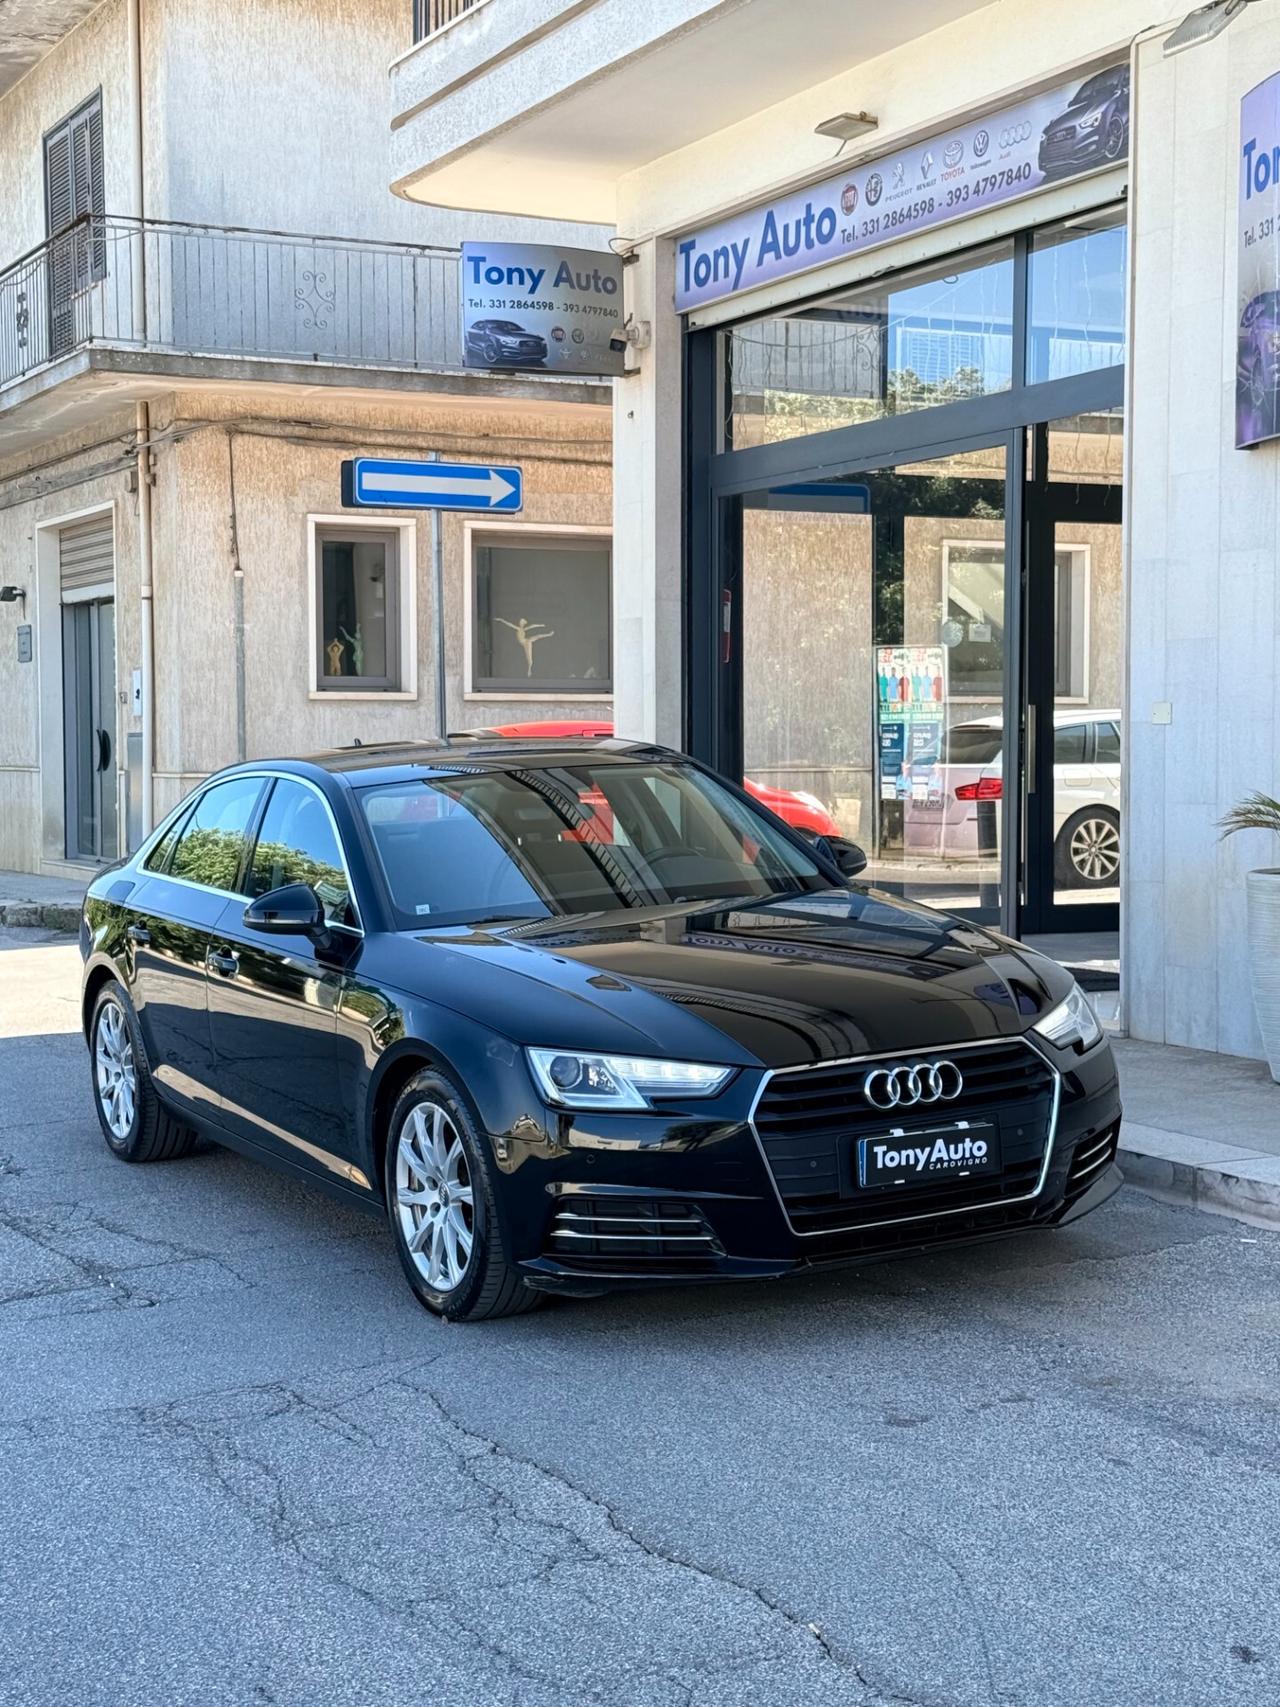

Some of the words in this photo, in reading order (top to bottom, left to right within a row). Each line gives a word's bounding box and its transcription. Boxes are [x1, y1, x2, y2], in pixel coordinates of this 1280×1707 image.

[916, 178, 937, 192] RENAULT
[940, 167, 966, 182] TOYOTA
[840, 226, 858, 245] Tel.
[862, 217, 880, 237] 331
[883, 197, 935, 231] 2864598
[946, 185, 969, 207] 393
[973, 161, 1031, 200] 4797840
[885, 188, 913, 202] PEUGEOT
[1244, 226, 1257, 248] Tel.
[1258, 217, 1274, 241] 331
[679, 236, 750, 293] Tony
[756, 202, 837, 268] Auto
[467, 256, 546, 295] Tony
[552, 260, 618, 295] Auto
[469, 298, 486, 309] Tel.
[489, 299, 506, 309] 331
[509, 299, 554, 311] 2864598
[563, 302, 580, 314] 393
[581, 305, 618, 318] 4797840
[873, 1137, 988, 1171] TonyAuto
[929, 1157, 988, 1170] CAROVIGNO
